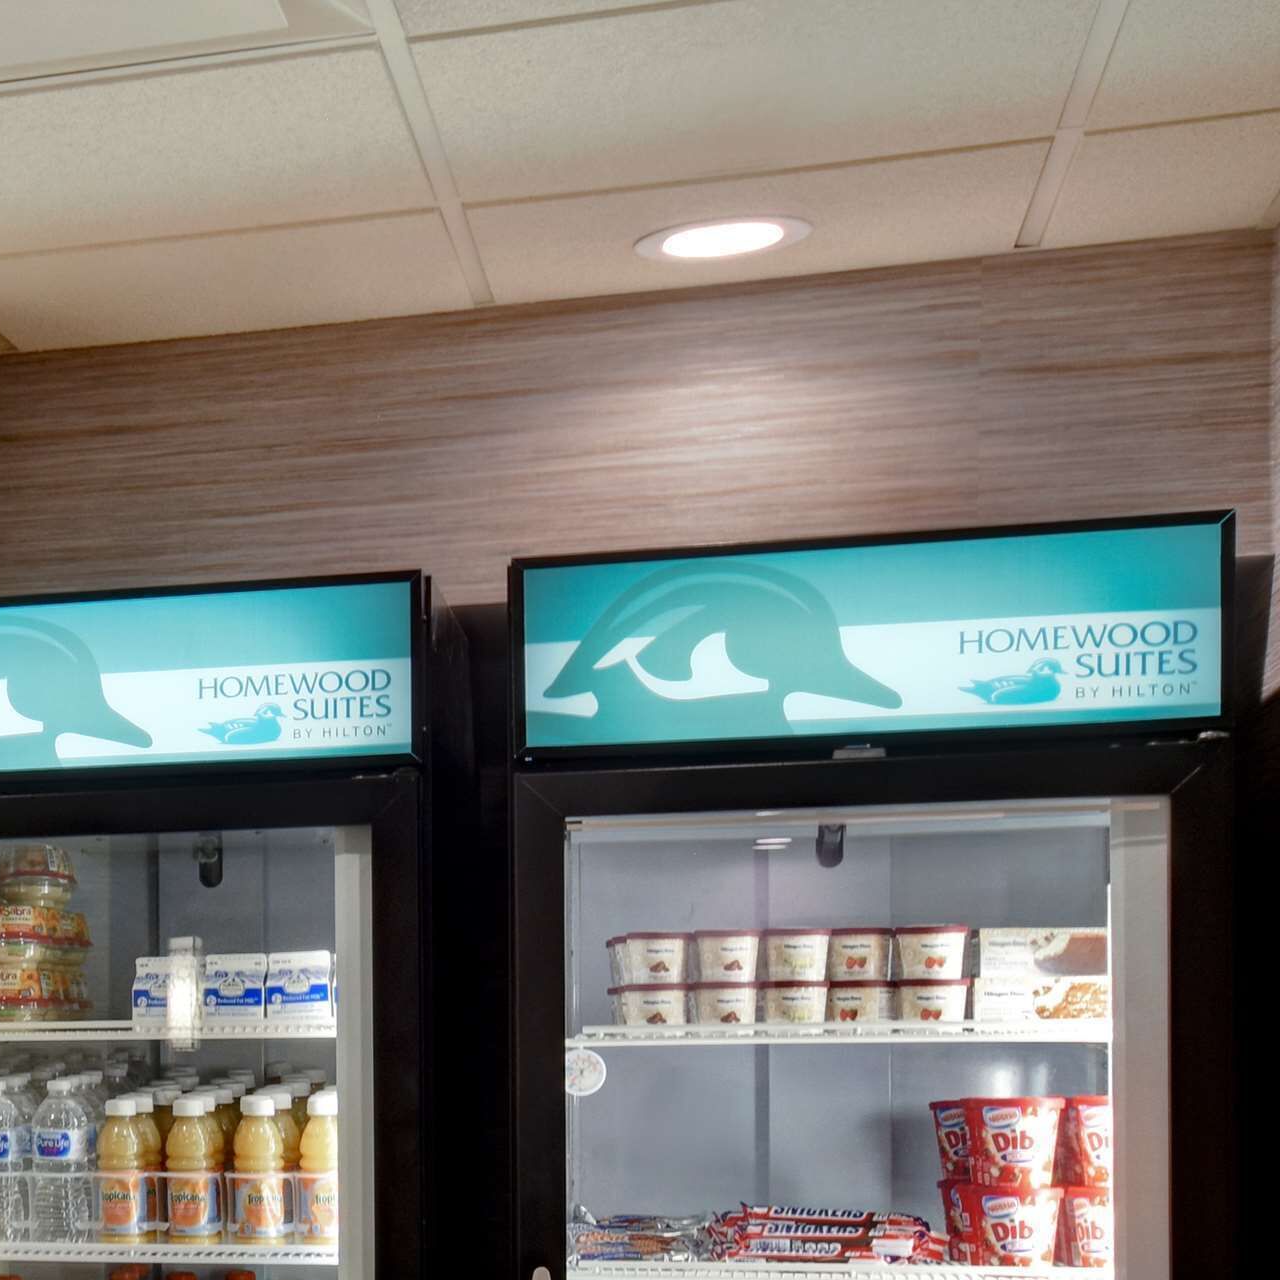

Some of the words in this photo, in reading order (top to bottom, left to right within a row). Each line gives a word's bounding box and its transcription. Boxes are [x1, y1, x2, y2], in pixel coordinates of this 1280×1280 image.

[958, 620, 1198, 655] HOMEWOOD
[1075, 649, 1198, 679] SUITES
[197, 668, 392, 700] HOMEWOOD
[1074, 686, 1100, 699] BY
[1111, 683, 1191, 698] HILTON
[292, 694, 392, 721] SUITES
[292, 727, 314, 740] BY
[322, 724, 388, 739] HILTON
